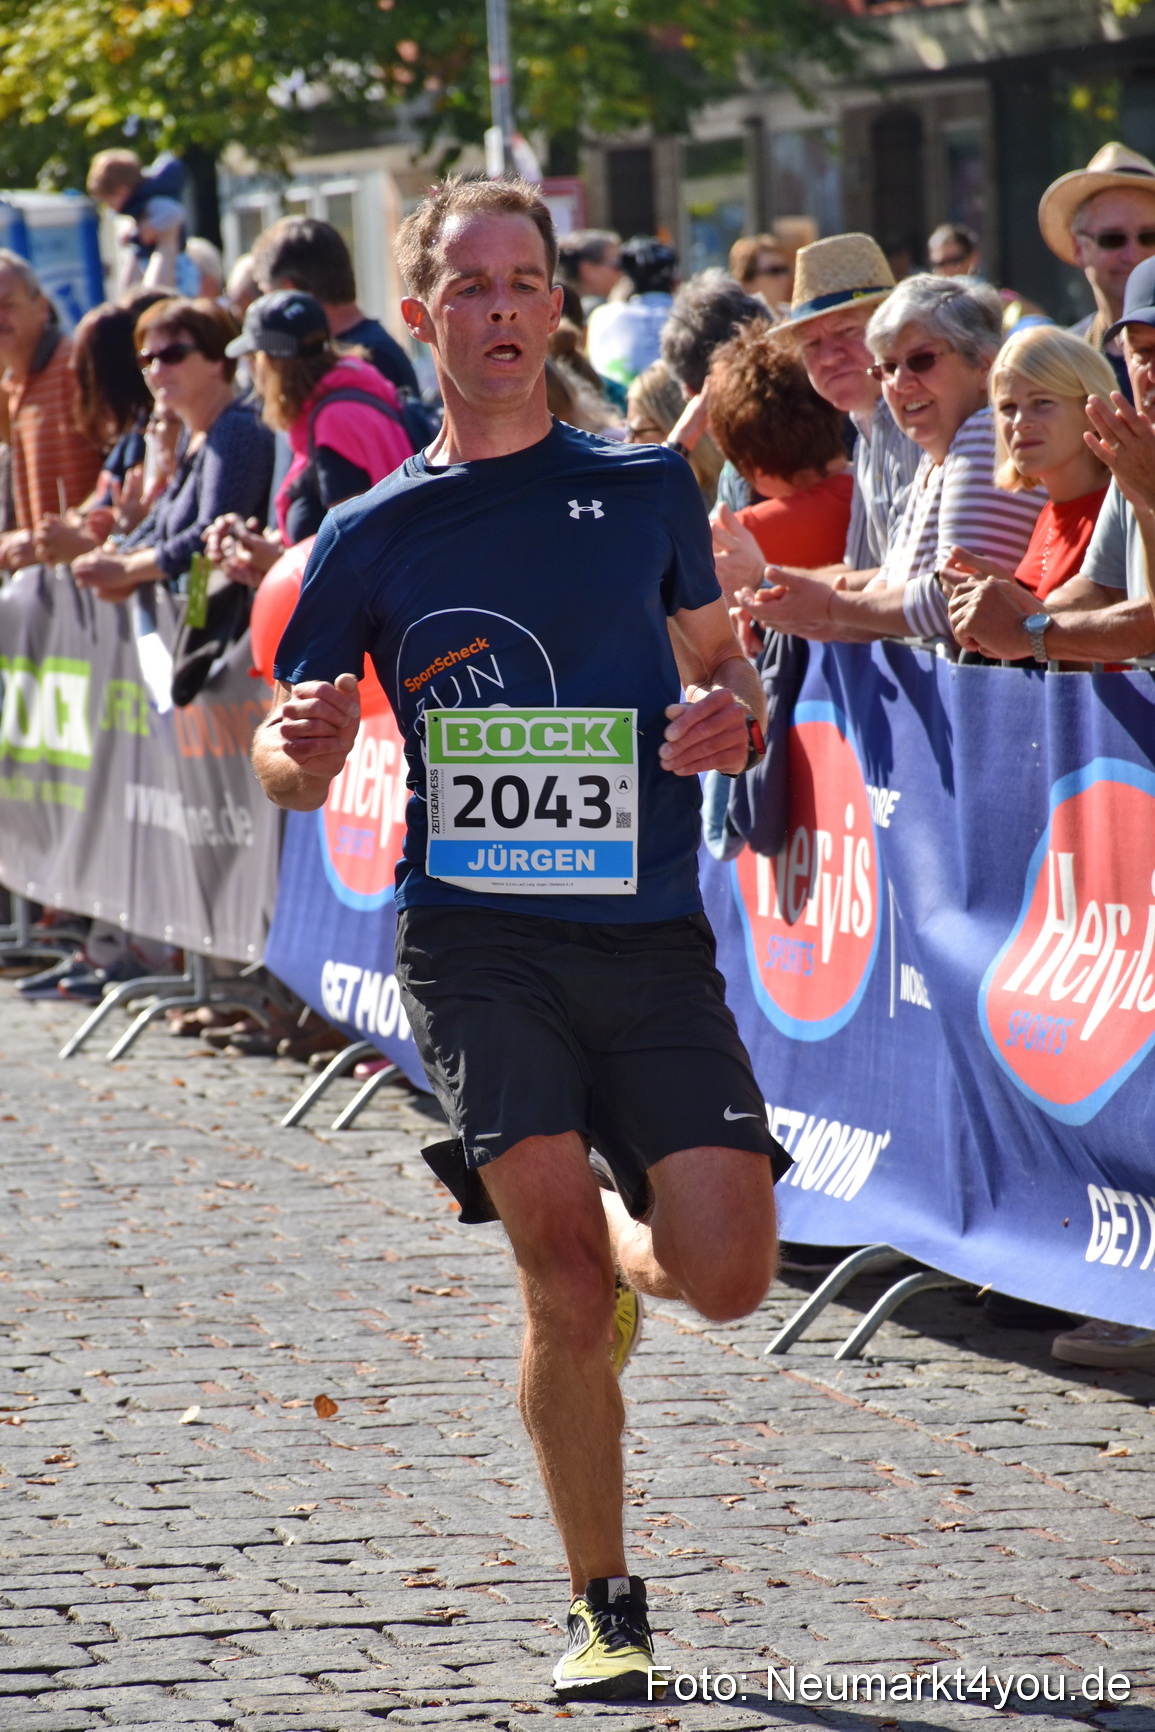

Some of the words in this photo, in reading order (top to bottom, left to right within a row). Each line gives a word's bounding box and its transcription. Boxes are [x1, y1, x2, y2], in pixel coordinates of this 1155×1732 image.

[404, 637, 490, 693] SportScheck
[442, 717, 620, 757] BOCK
[453, 775, 612, 829] 2043
[619, 779, 628, 790] A
[468, 844, 595, 872] JÜRGEN
[765, 935, 815, 976] SPORTS
[321, 960, 362, 1023] GET
[1005, 1009, 1076, 1056] SPORTS
[1085, 1186, 1138, 1268] GET
